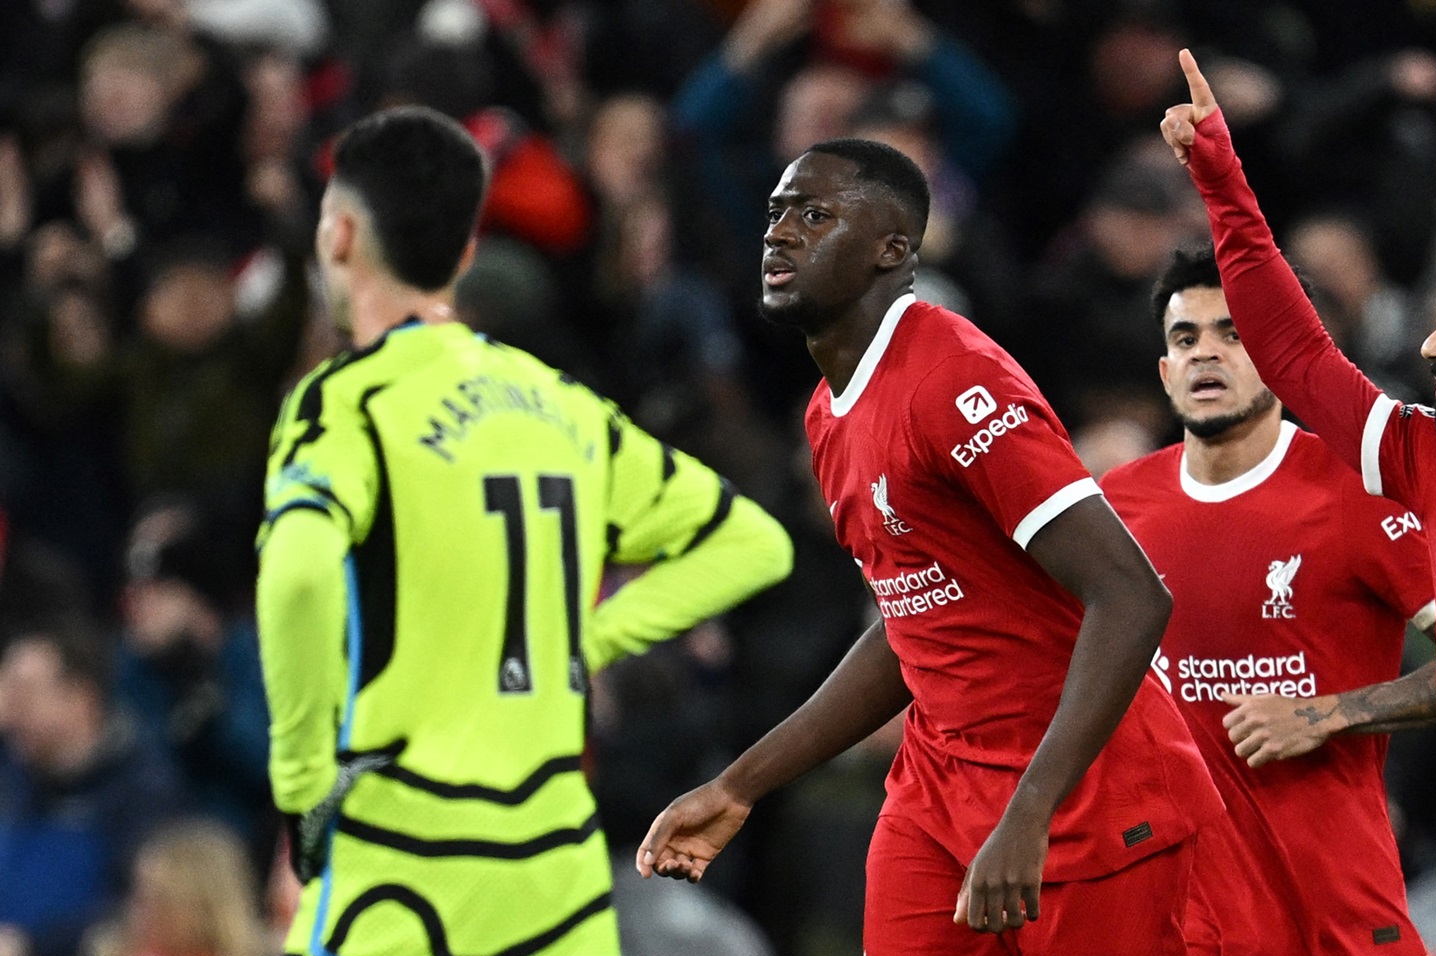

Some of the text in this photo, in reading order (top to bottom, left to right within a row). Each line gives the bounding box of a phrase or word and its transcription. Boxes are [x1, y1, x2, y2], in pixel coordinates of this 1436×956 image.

[418, 373, 596, 464] MARTINEI
[950, 402, 1030, 468] Expedia
[483, 474, 589, 694] 11
[880, 578, 965, 618] chartered
[1178, 651, 1306, 679] standard
[1180, 672, 1317, 702] chartered
